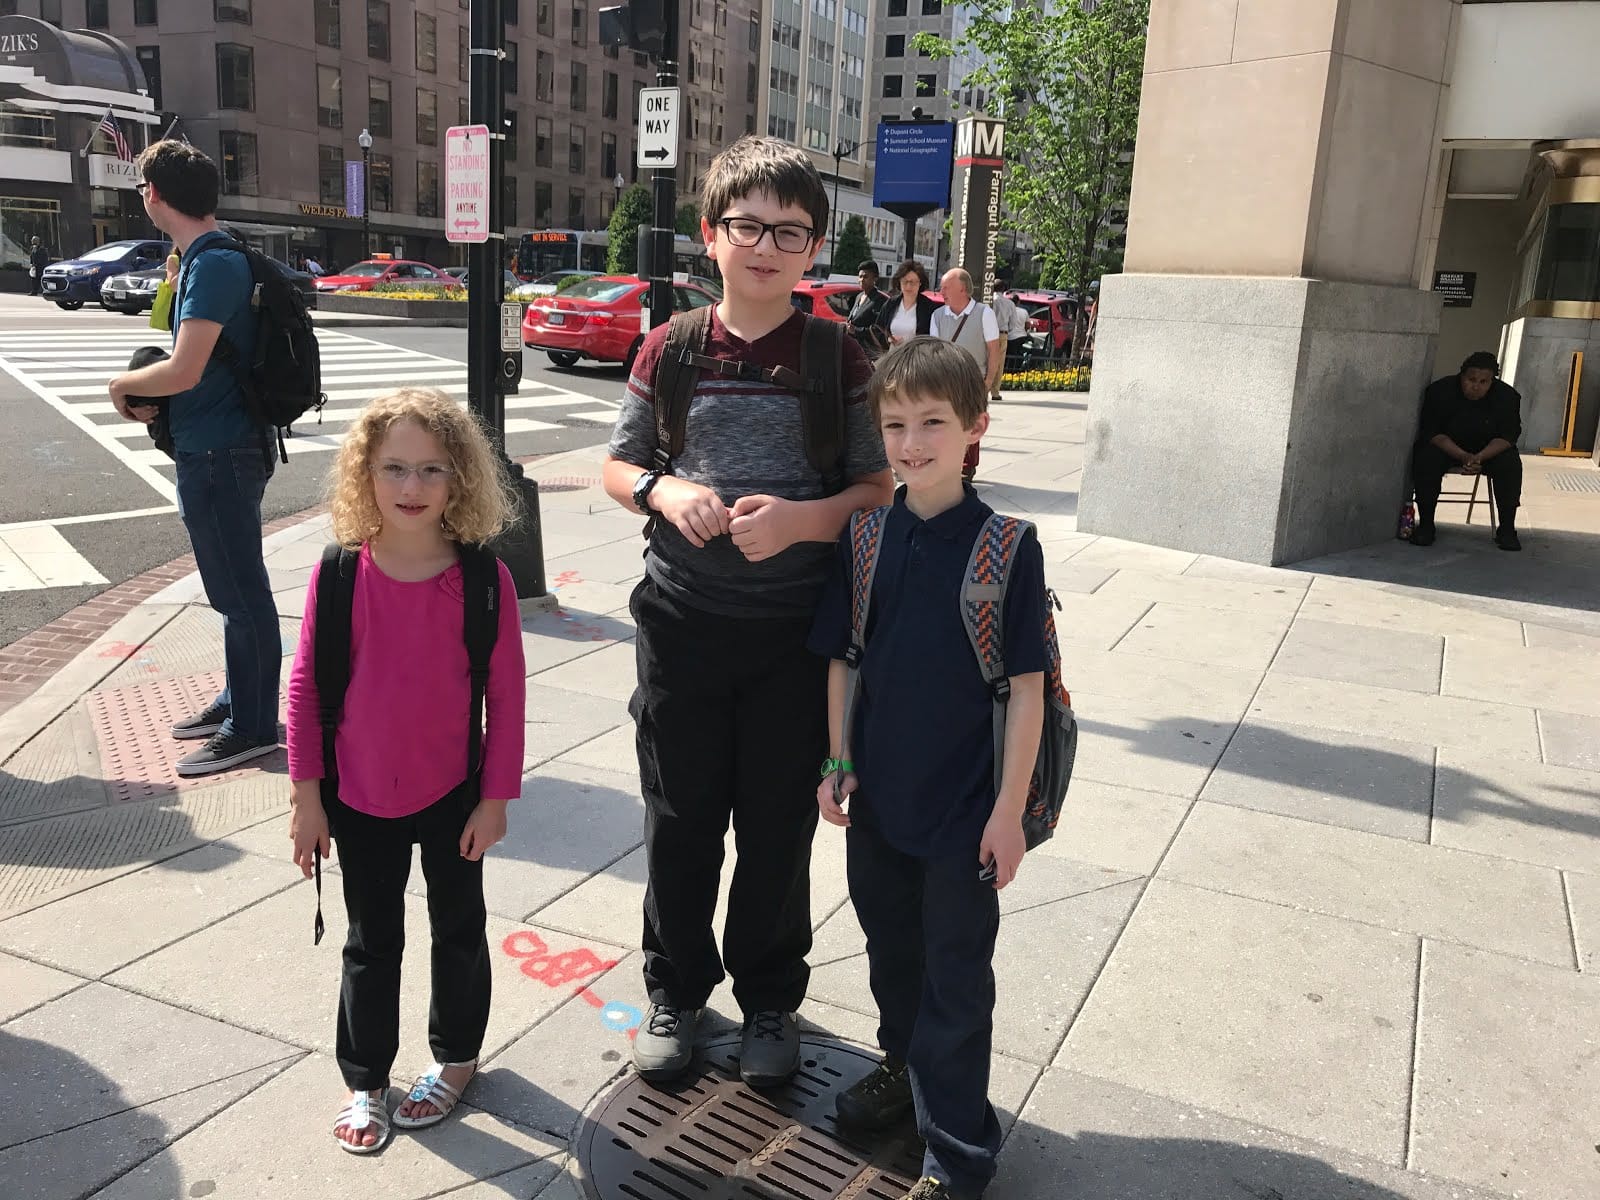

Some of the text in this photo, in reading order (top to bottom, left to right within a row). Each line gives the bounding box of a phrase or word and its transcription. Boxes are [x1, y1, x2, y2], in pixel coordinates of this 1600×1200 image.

[646, 97, 670, 112] ONE
[645, 119, 670, 134] WAY
[957, 122, 973, 157] M
[974, 121, 1005, 157] M
[910, 147, 938, 155] Geographic
[449, 153, 485, 170] STANDING
[107, 163, 142, 177] RIZI
[451, 181, 483, 199] PARKING
[300, 203, 336, 217] WELLS
[456, 202, 477, 214] ANYTIME
[532, 232, 541, 242] NOT
[549, 232, 568, 242] SERVICE
[982, 170, 1003, 305] Farragut North Stati
[958, 228, 967, 267] North
